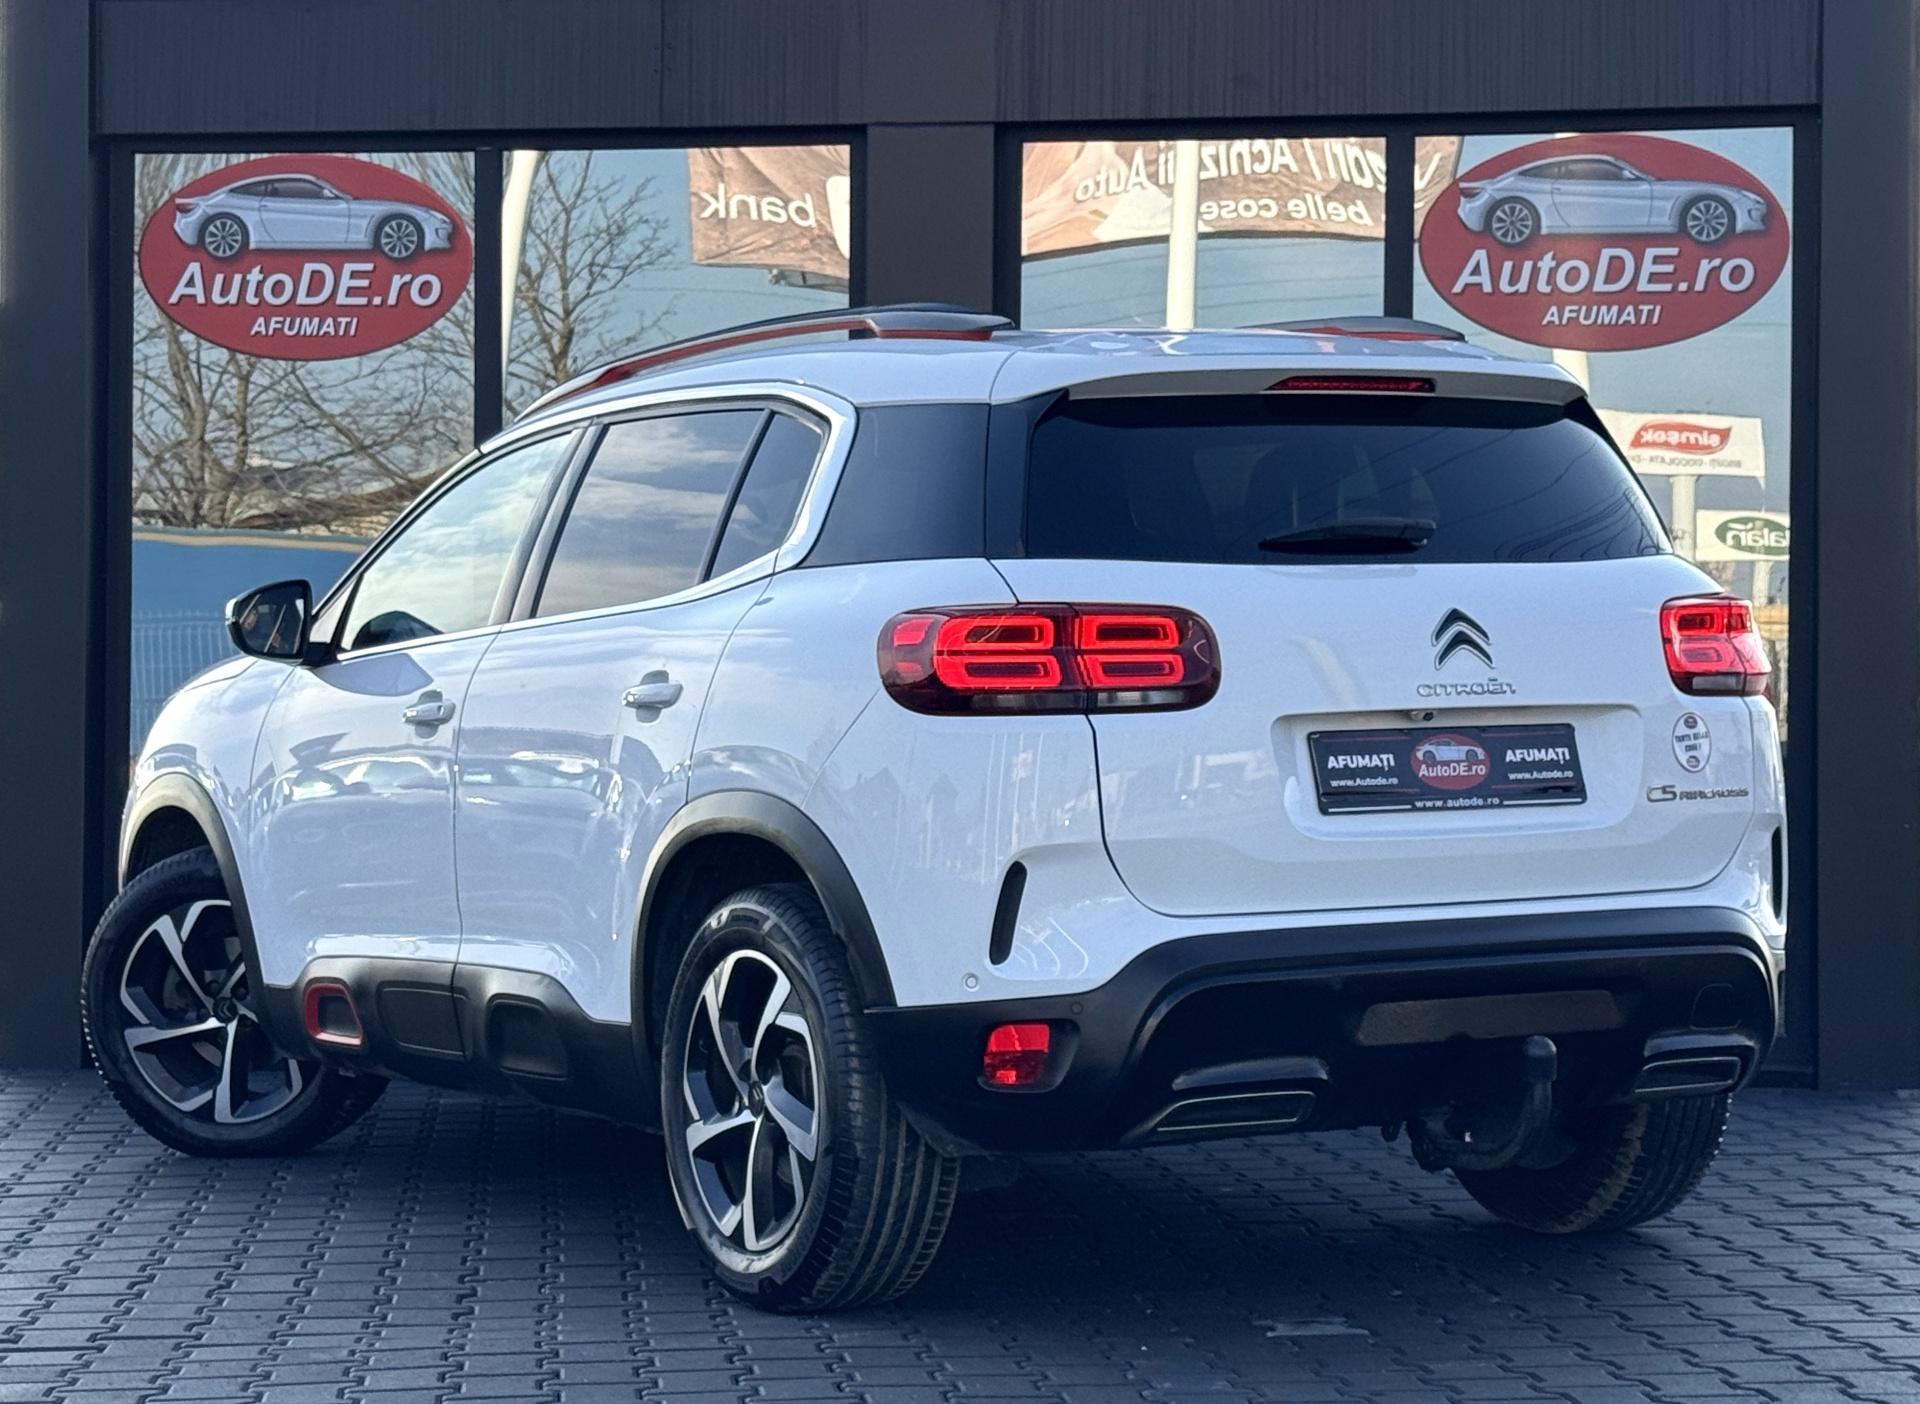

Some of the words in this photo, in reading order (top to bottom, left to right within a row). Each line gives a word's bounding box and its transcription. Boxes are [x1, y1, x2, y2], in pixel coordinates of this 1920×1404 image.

[1452, 248, 1756, 294] AutoDE.ro
[169, 262, 443, 307] AutoDE.ro
[1542, 305, 1661, 326] AFUMATI
[250, 317, 359, 337] AFUMATI
[1418, 762, 1487, 778] AutoDE.ro
[1414, 796, 1500, 809] www.autode.ro
